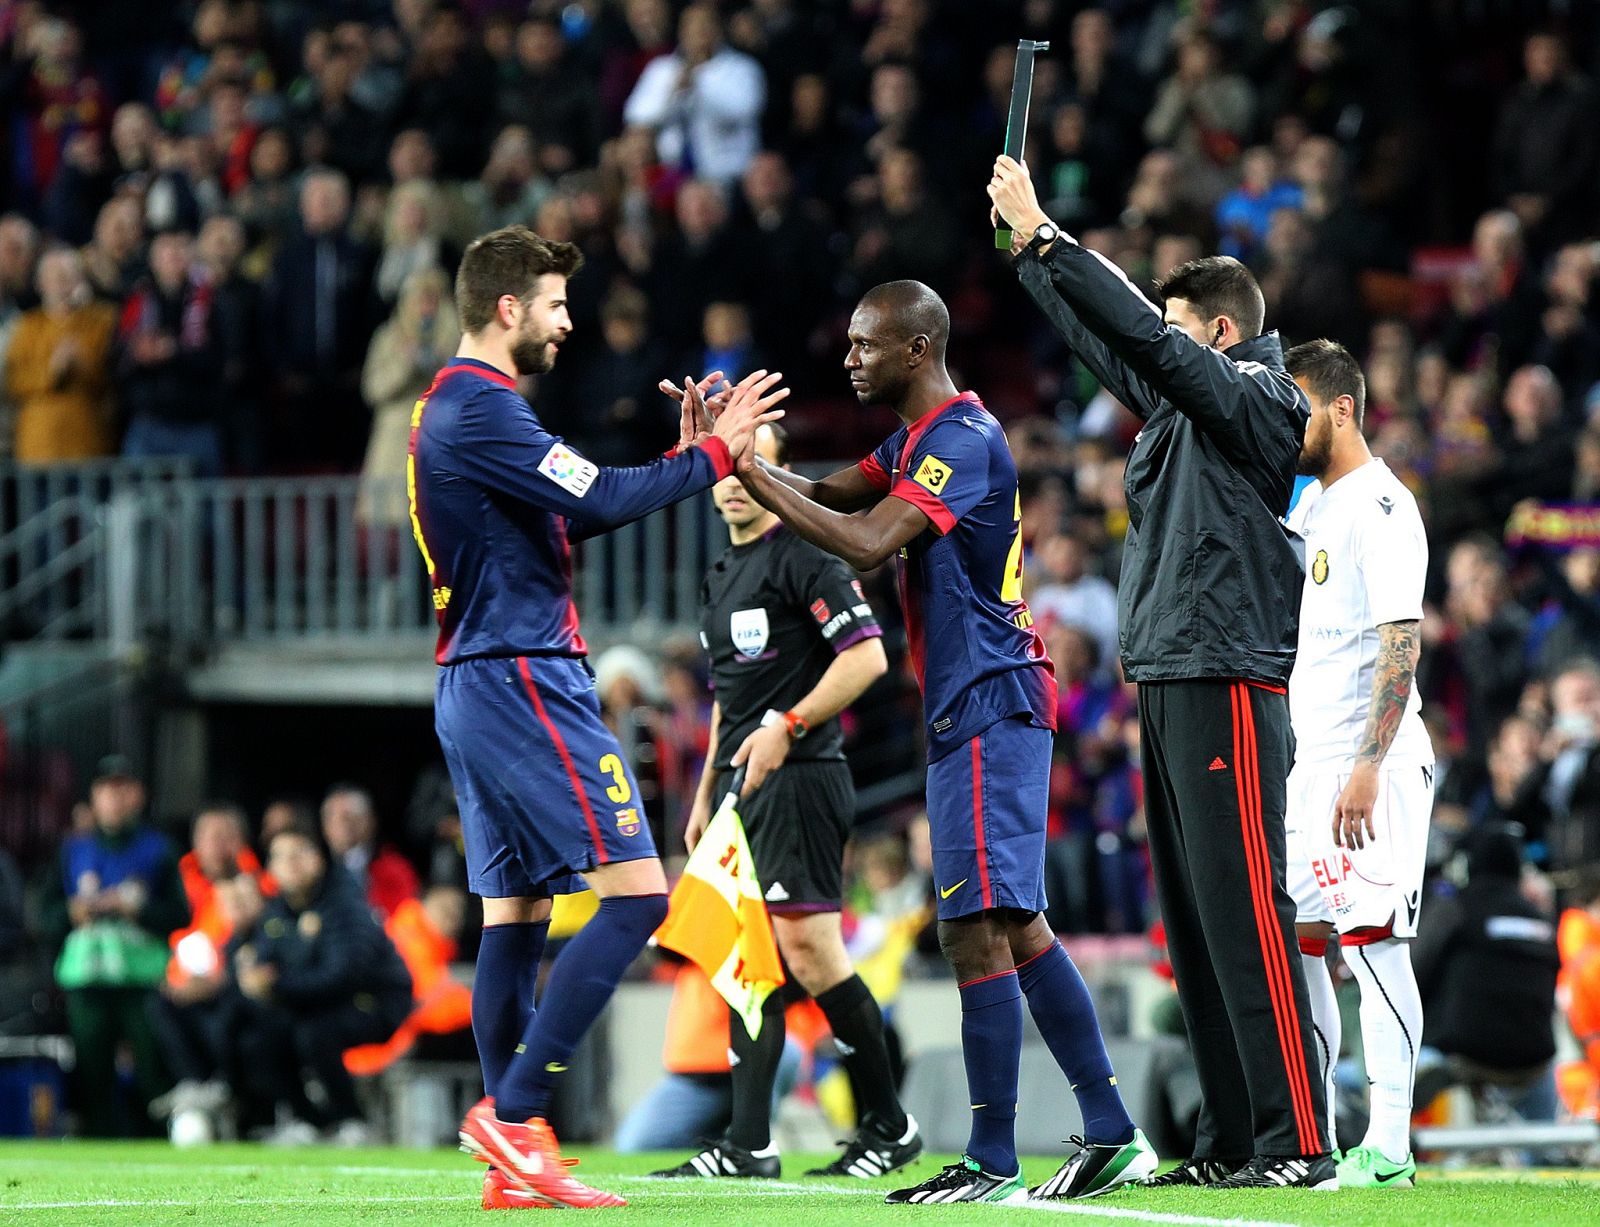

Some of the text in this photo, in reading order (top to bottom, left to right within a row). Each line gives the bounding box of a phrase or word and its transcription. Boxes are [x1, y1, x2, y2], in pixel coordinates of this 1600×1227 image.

[928, 468, 945, 487] 3
[737, 628, 762, 640] FIFA
[599, 753, 632, 805] 3
